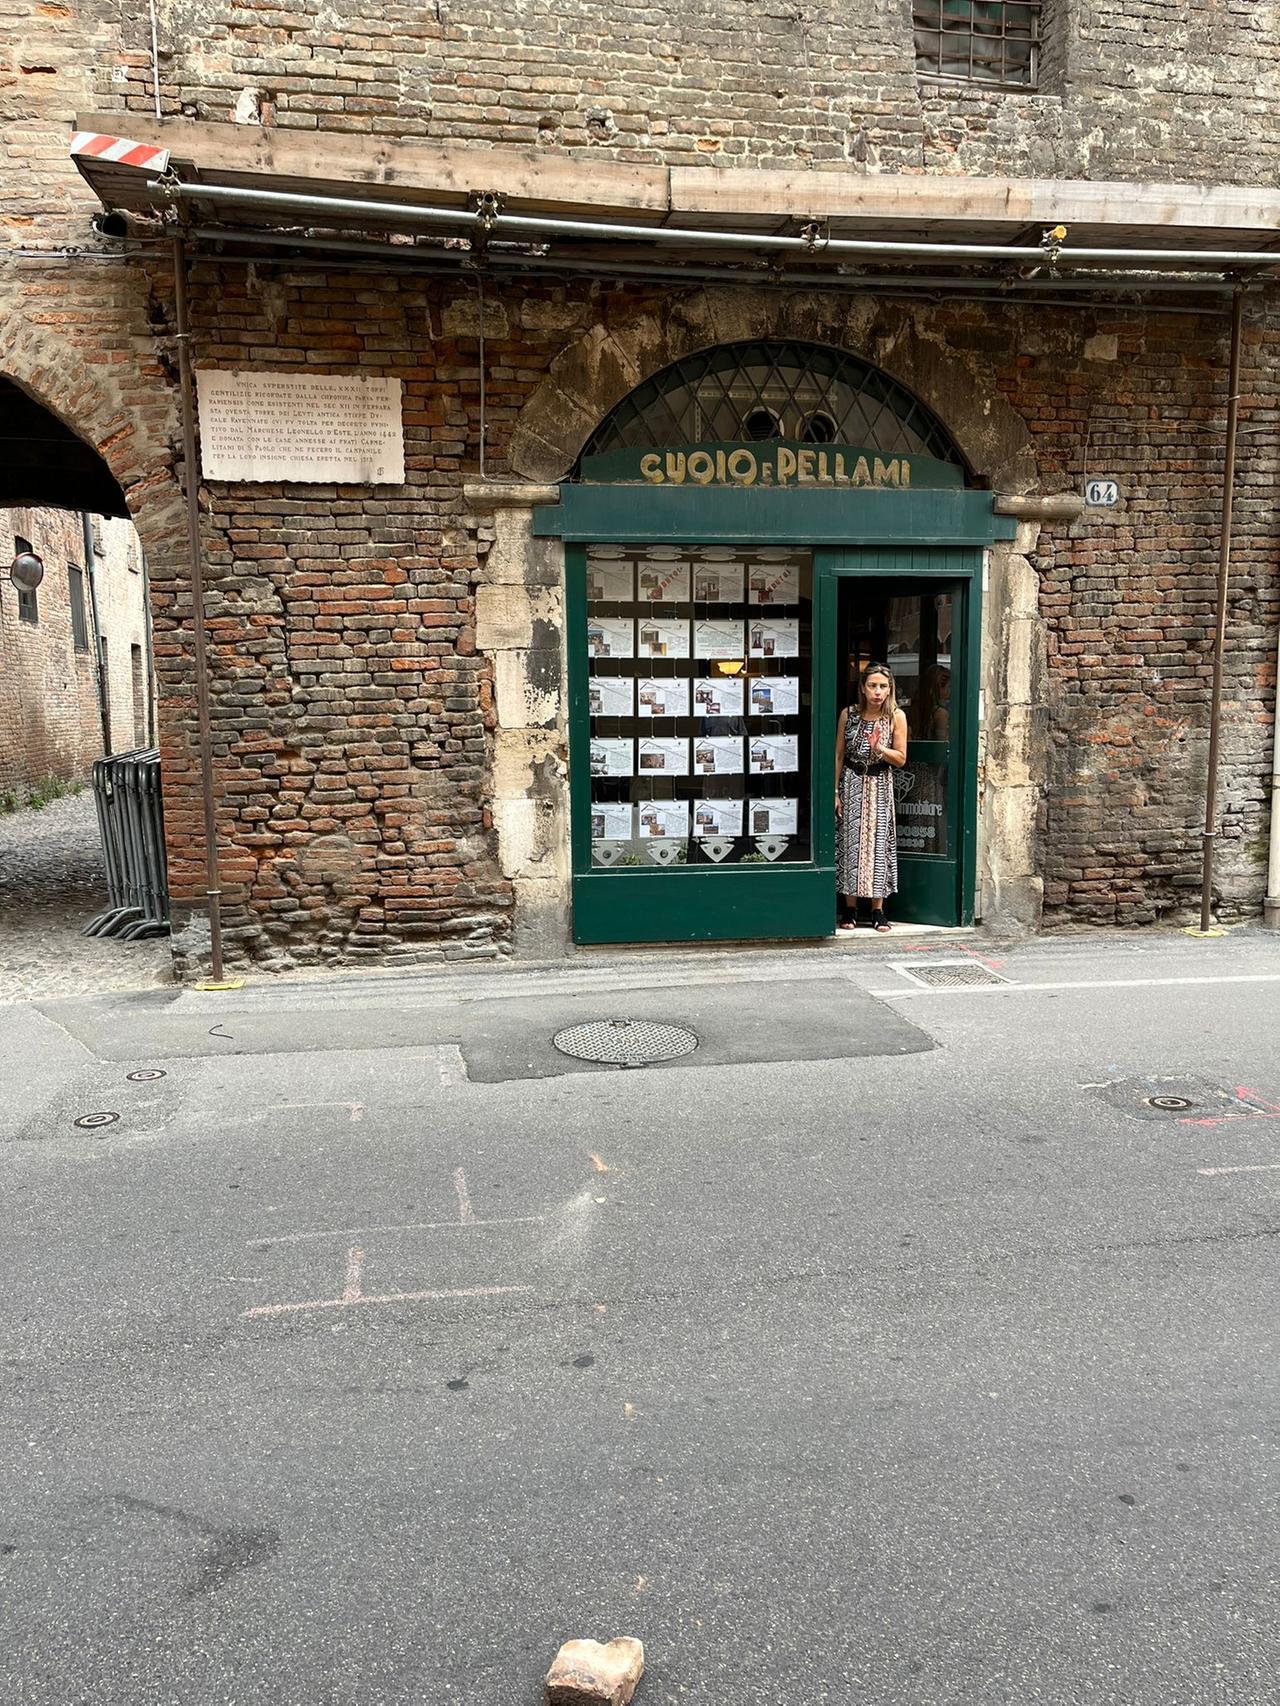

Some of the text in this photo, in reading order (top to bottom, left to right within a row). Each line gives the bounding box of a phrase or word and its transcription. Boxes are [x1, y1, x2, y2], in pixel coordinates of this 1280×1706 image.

[640, 447, 911, 488] CUOIO E PELLAMI
[1090, 484, 1113, 502] 64
